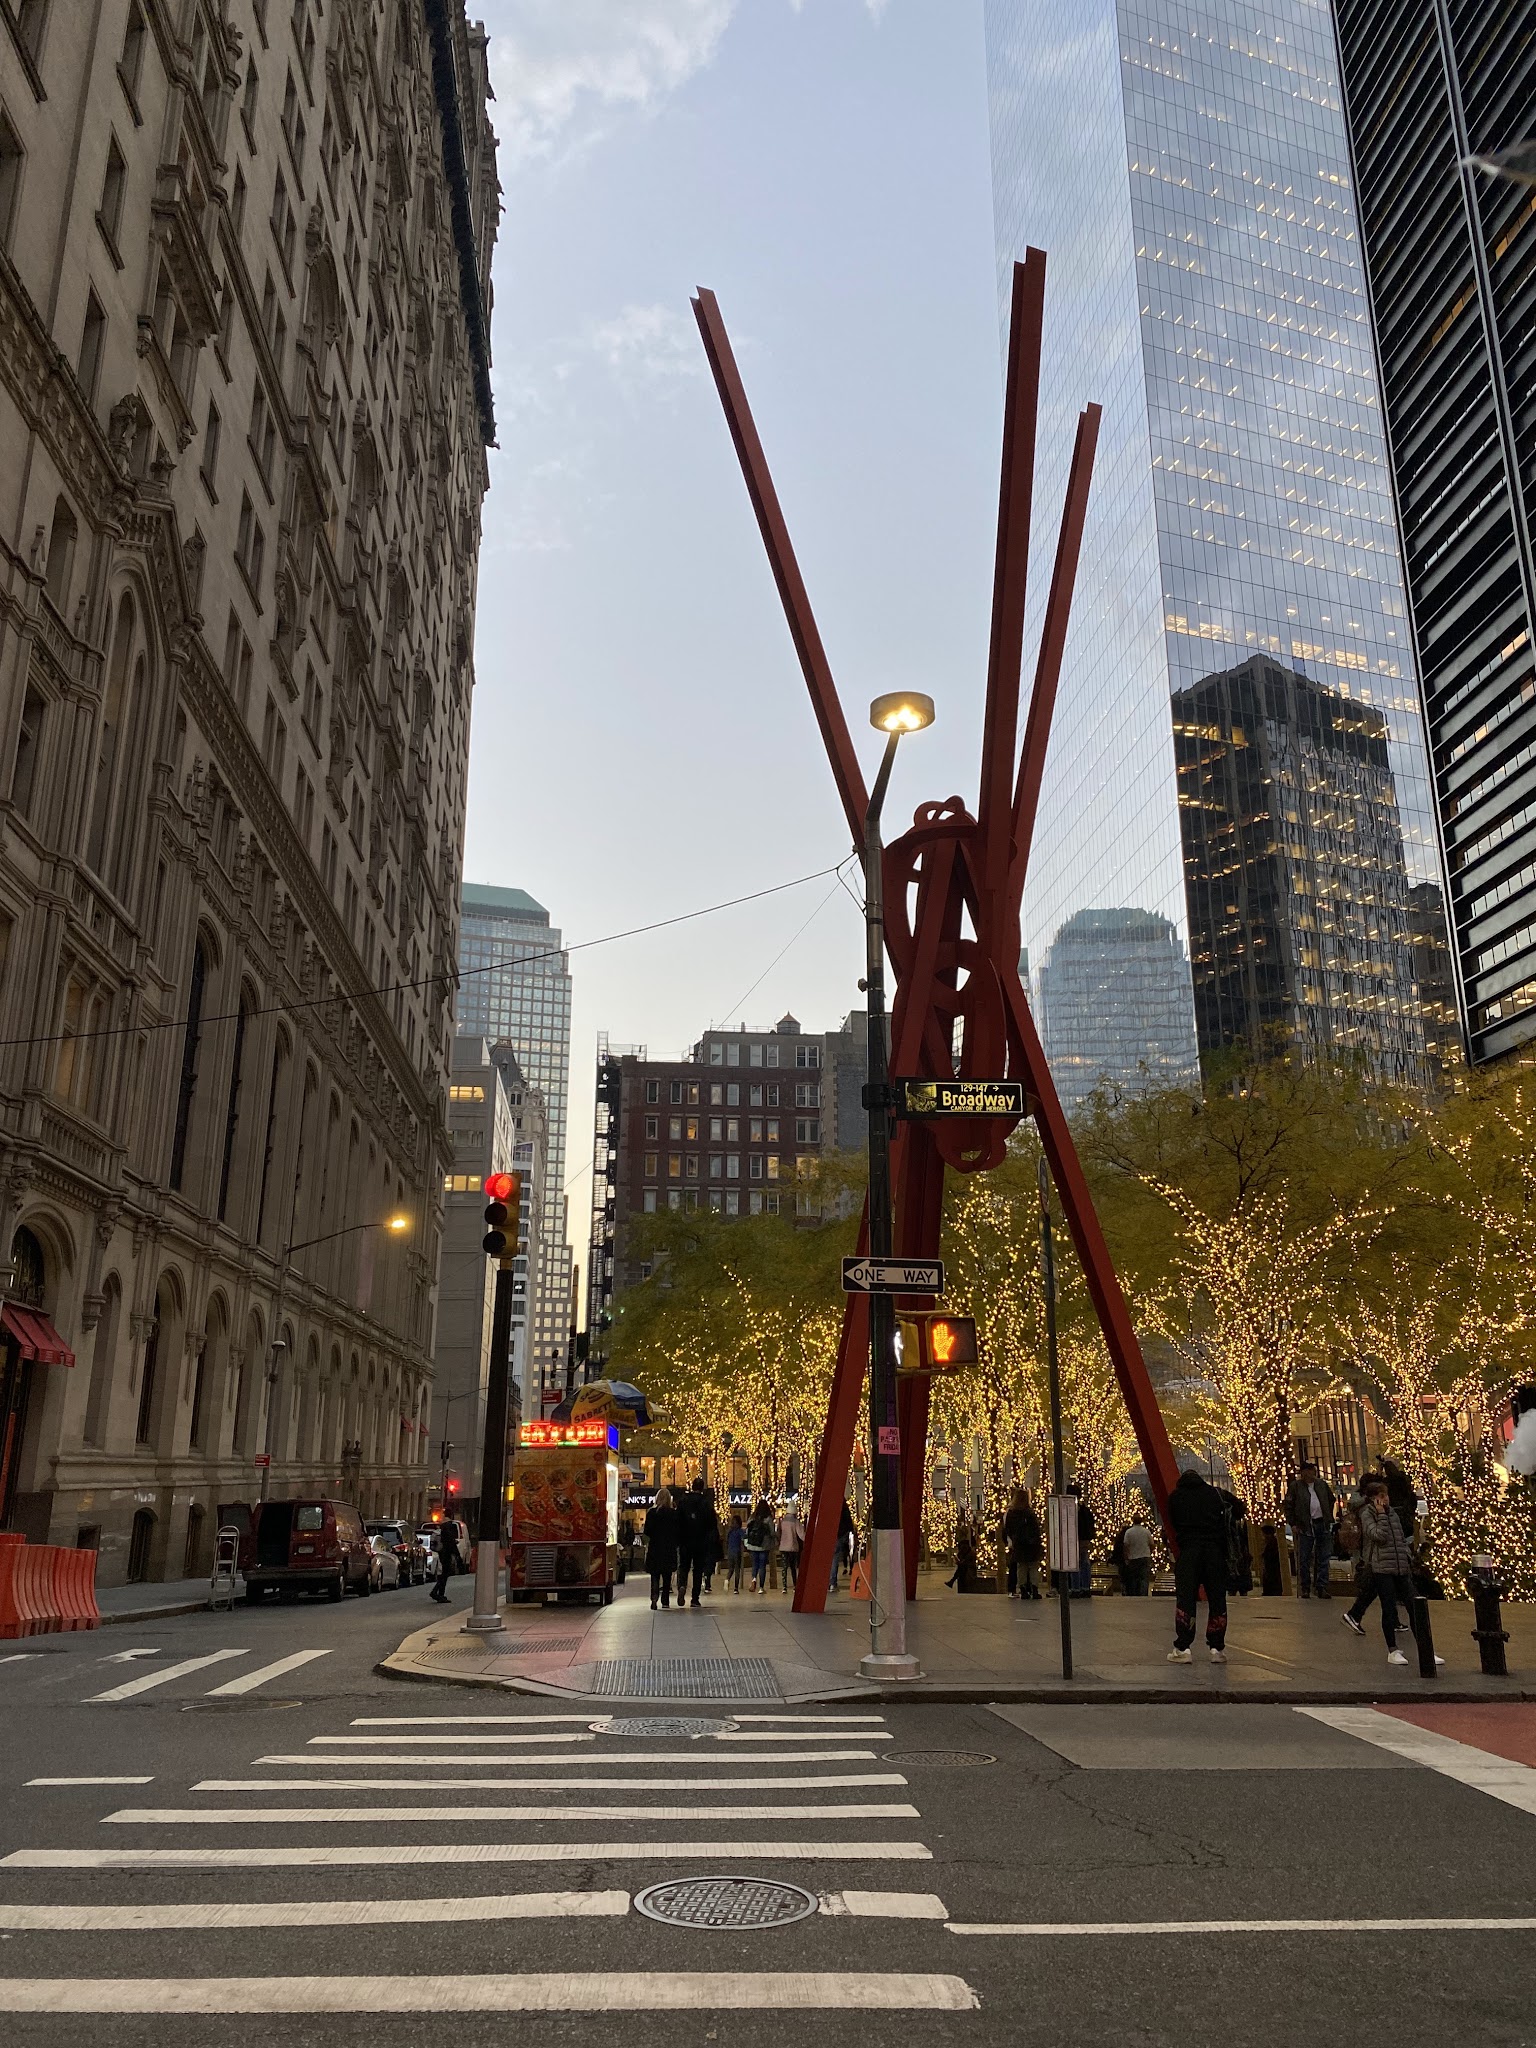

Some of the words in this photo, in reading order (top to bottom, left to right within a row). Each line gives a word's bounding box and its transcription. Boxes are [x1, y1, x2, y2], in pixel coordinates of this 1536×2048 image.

[942, 1091, 1015, 1111] Broadway
[853, 1268, 886, 1282] ONE
[903, 1269, 934, 1283] WAY
